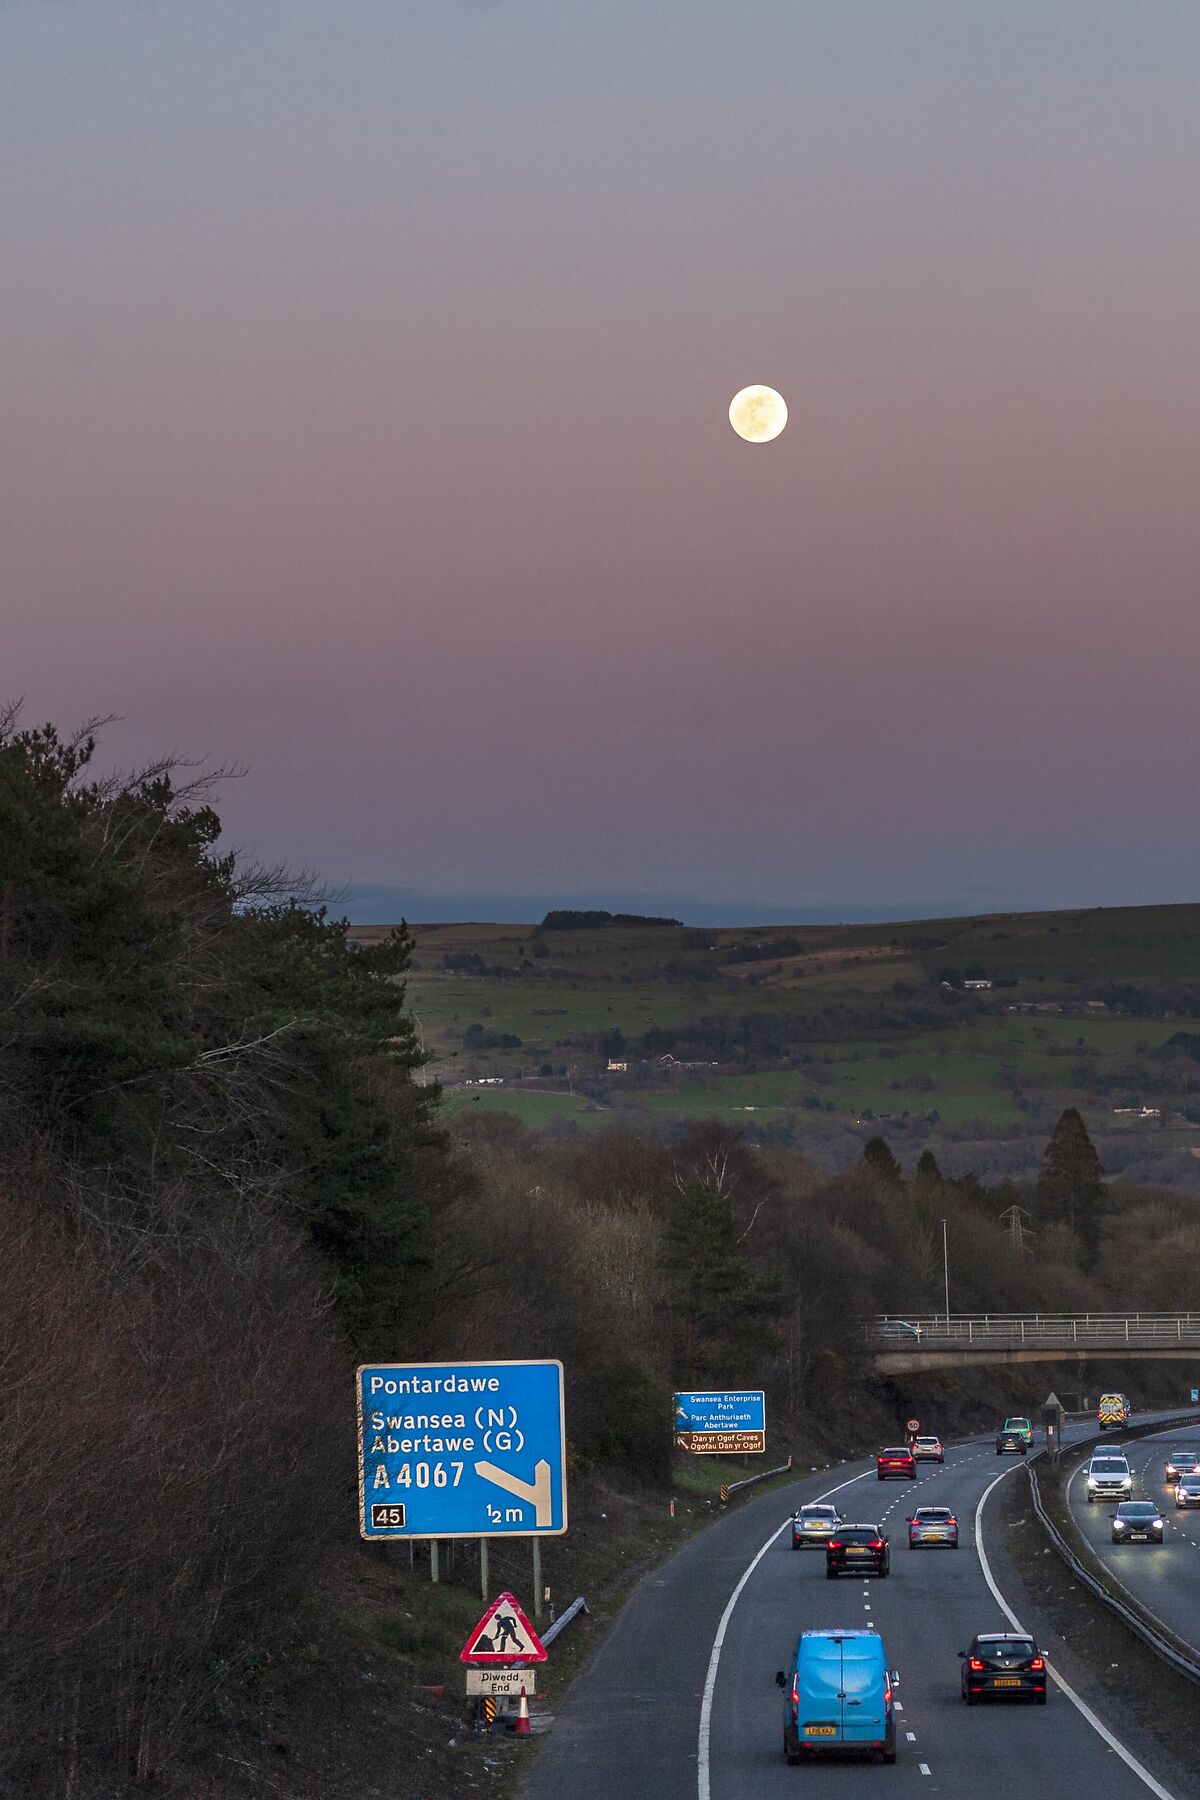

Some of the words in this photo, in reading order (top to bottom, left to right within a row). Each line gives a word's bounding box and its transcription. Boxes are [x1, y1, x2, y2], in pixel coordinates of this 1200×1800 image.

[371, 1375, 500, 1394] Pontardawe
[690, 1395, 722, 1403] Swansea
[724, 1395, 761, 1403] Enterprise
[371, 1412, 466, 1431] Swansea
[474, 1405, 518, 1430] (N)
[371, 1434, 475, 1454] Abertawe
[483, 1429, 525, 1452] (G)
[717, 1434, 735, 1442] Ogof
[736, 1433, 759, 1441] Caves
[690, 1442, 717, 1450] Ogofau
[743, 1441, 761, 1449] Ogof
[373, 1463, 390, 1489] A
[396, 1461, 464, 1489] 4067
[376, 1508, 401, 1524] 45
[482, 1673, 519, 1681] Diwedd
[491, 1684, 510, 1692] End
